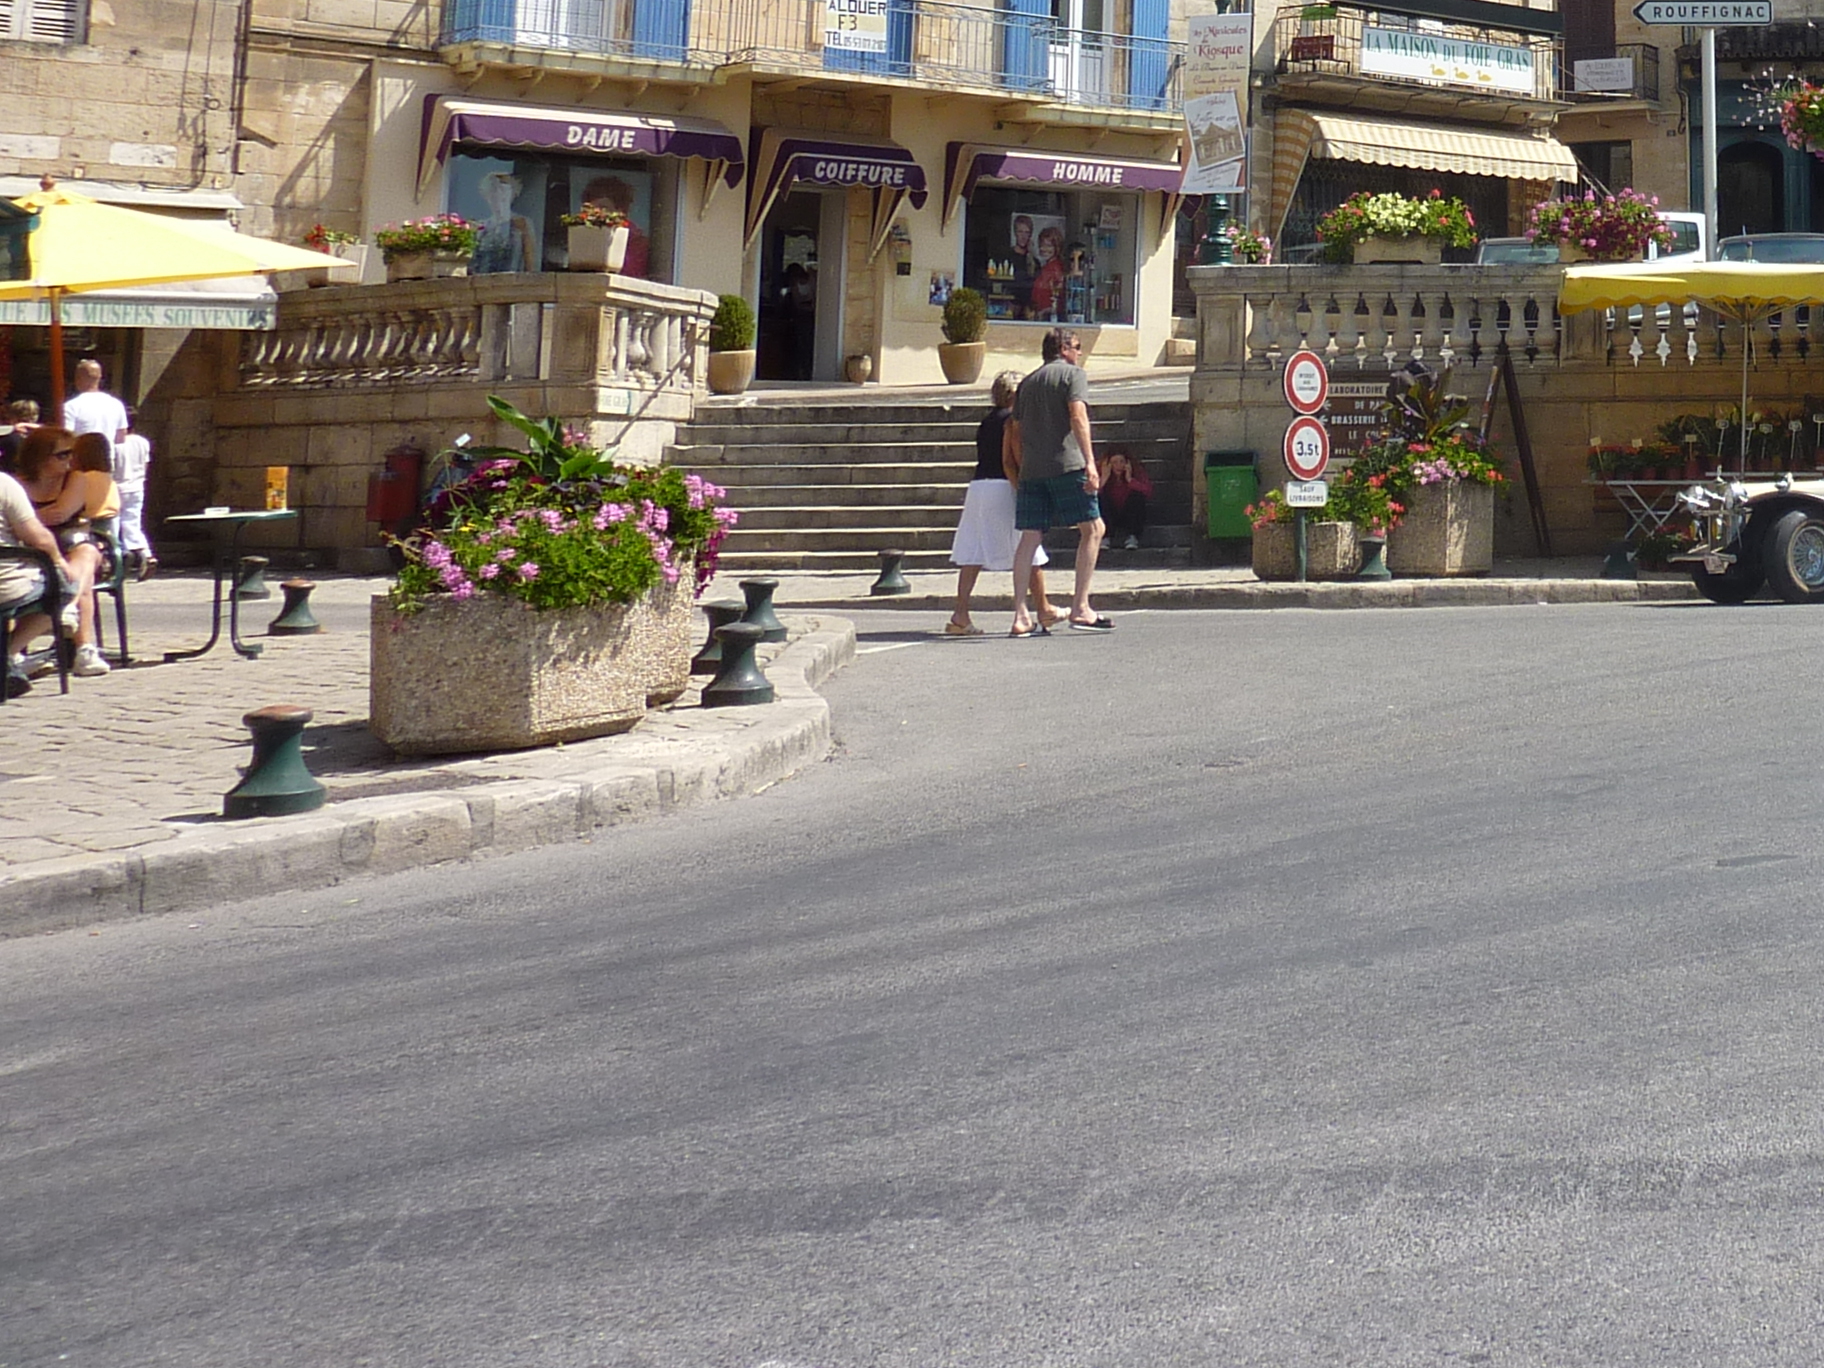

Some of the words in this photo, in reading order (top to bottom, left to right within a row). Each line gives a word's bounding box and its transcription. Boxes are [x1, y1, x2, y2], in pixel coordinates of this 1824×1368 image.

[1653, 6, 1765, 19] ROUFFIGNAC
[1194, 44, 1244, 60] Kiosque
[1366, 33, 1381, 53] LA
[1387, 33, 1439, 61] MAISON
[1443, 44, 1461, 63] DU
[1464, 44, 1493, 68] FOIE
[1497, 47, 1531, 72] GRAS
[567, 125, 636, 148] DAME
[814, 161, 905, 184] COIFFURE
[1053, 162, 1123, 183] HOMME
[37, 301, 71, 323] DS
[83, 303, 155, 326] MUSEES
[163, 306, 269, 330] SOUVENIRS
[1330, 385, 1384, 394] LABORATOIRE
[1331, 415, 1376, 425] BRASSERIE
